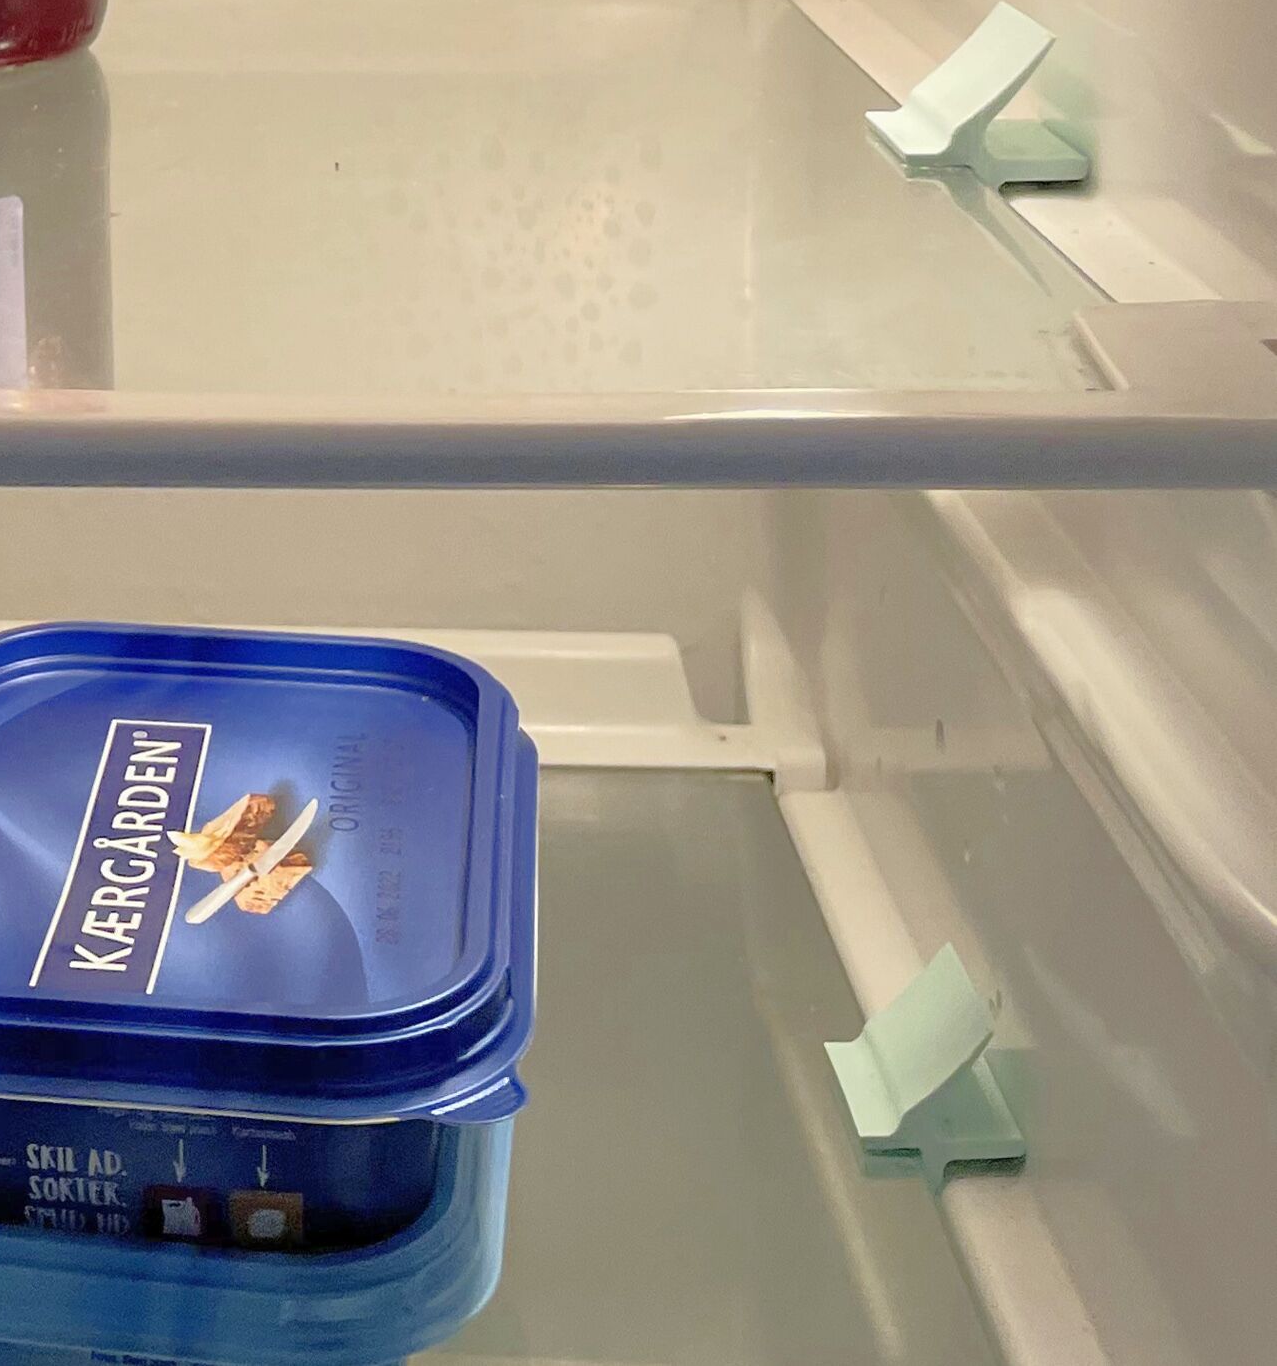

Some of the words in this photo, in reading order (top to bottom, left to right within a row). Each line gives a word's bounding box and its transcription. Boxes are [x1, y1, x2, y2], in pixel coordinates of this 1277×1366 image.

[328, 732, 368, 833] ORIGINAL
[25, 1142, 78, 1173] SKIL
[27, 1174, 128, 1208] SORTER.
